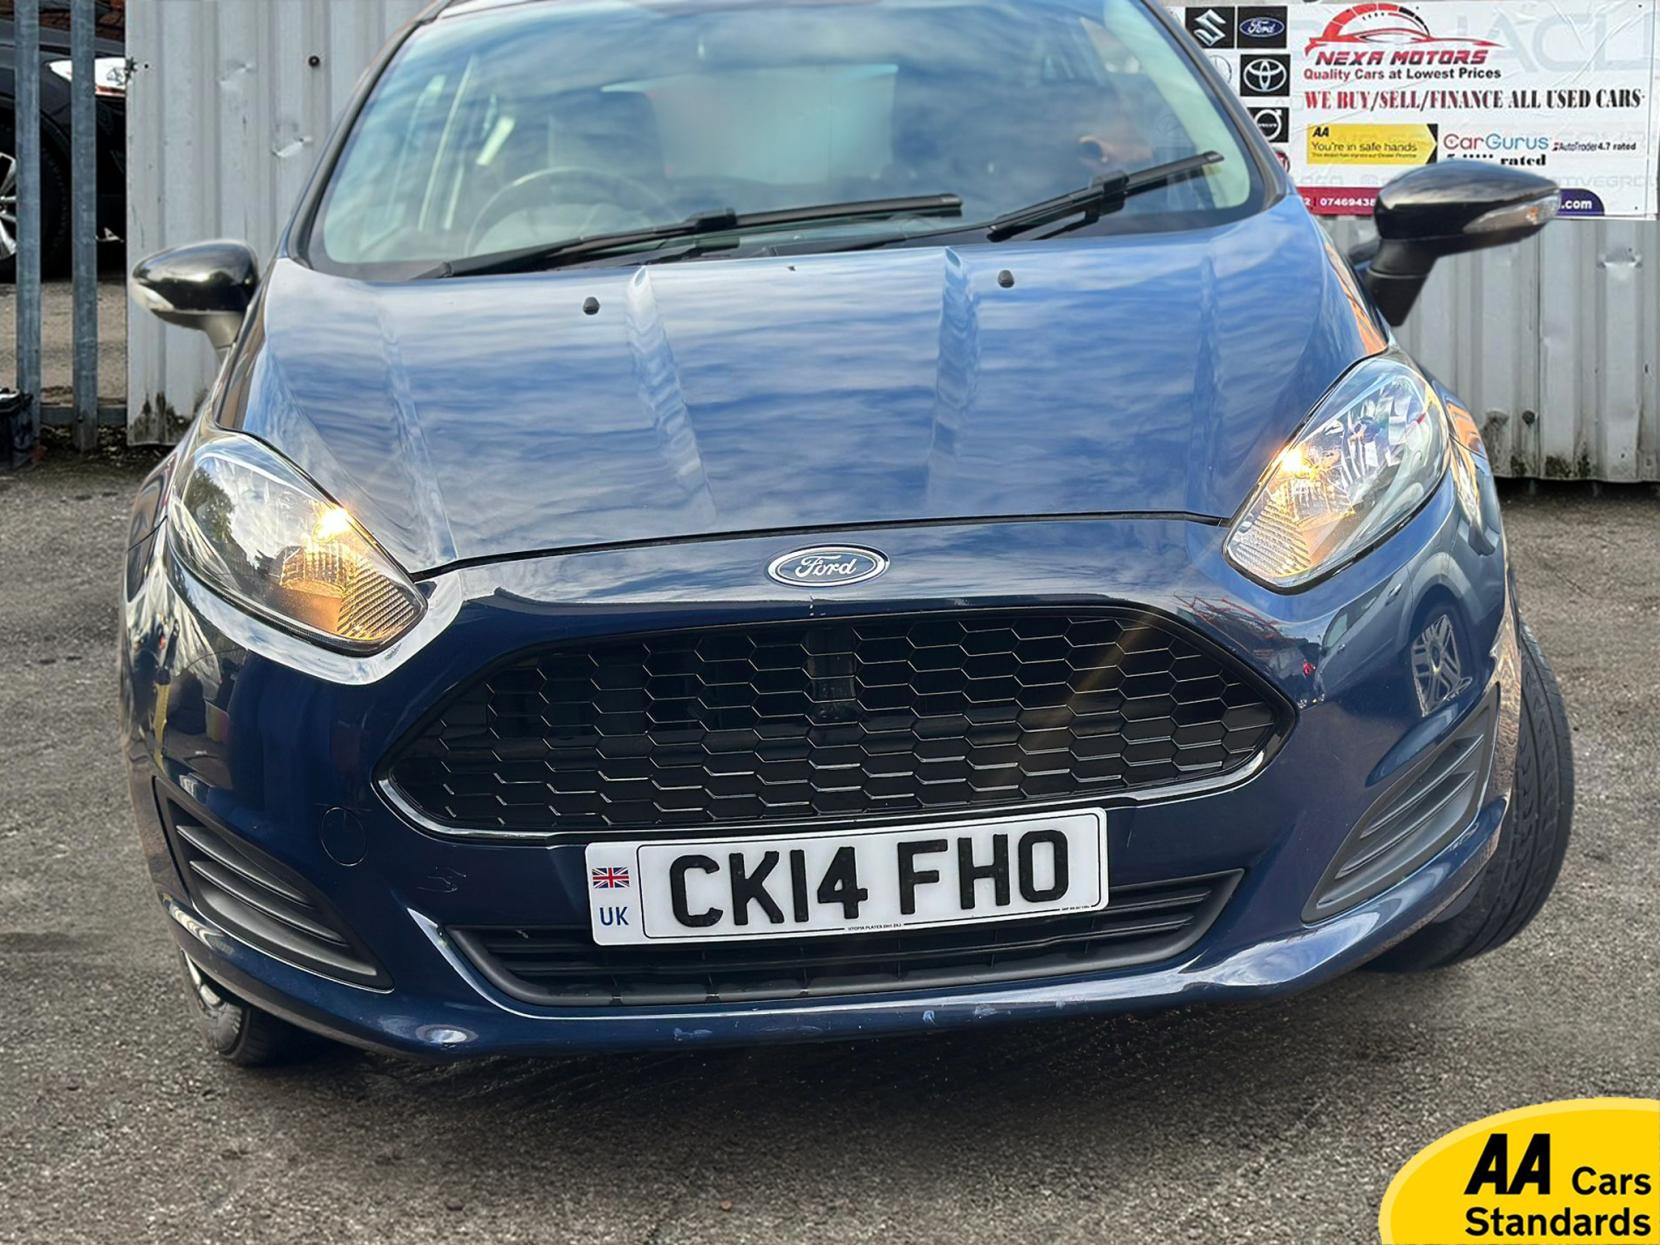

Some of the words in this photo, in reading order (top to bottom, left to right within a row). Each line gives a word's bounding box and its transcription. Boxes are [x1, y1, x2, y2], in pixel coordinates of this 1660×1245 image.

[1315, 50, 1385, 65] NEXA
[1389, 50, 1489, 65] MOTORS
[1303, 68, 1350, 82] Quality
[1355, 68, 1385, 80] Cars
[1388, 68, 1402, 79] at
[1406, 67, 1454, 80] Lowest
[1458, 67, 1502, 79] Prices
[1304, 90, 1332, 109] WE
[1337, 89, 1504, 112] BUY/SELL/FINANCE
[1508, 90, 1541, 109] ALL
[1546, 89, 1591, 109] USED
[1312, 126, 1329, 138] AA
[1311, 141, 1345, 152] You're
[1347, 142, 1357, 152] in
[1359, 141, 1381, 152] safe
[1383, 141, 1418, 152] hands
[1443, 133, 1550, 150] CarGurus
[1597, 142, 1611, 151] 4.7
[1613, 141, 1637, 151] rated
[1500, 153, 1547, 166] rated
[794, 554, 858, 578] Ford
[669, 846, 869, 928] CK14
[897, 829, 1068, 915] FHO
[600, 906, 629, 926] UK
